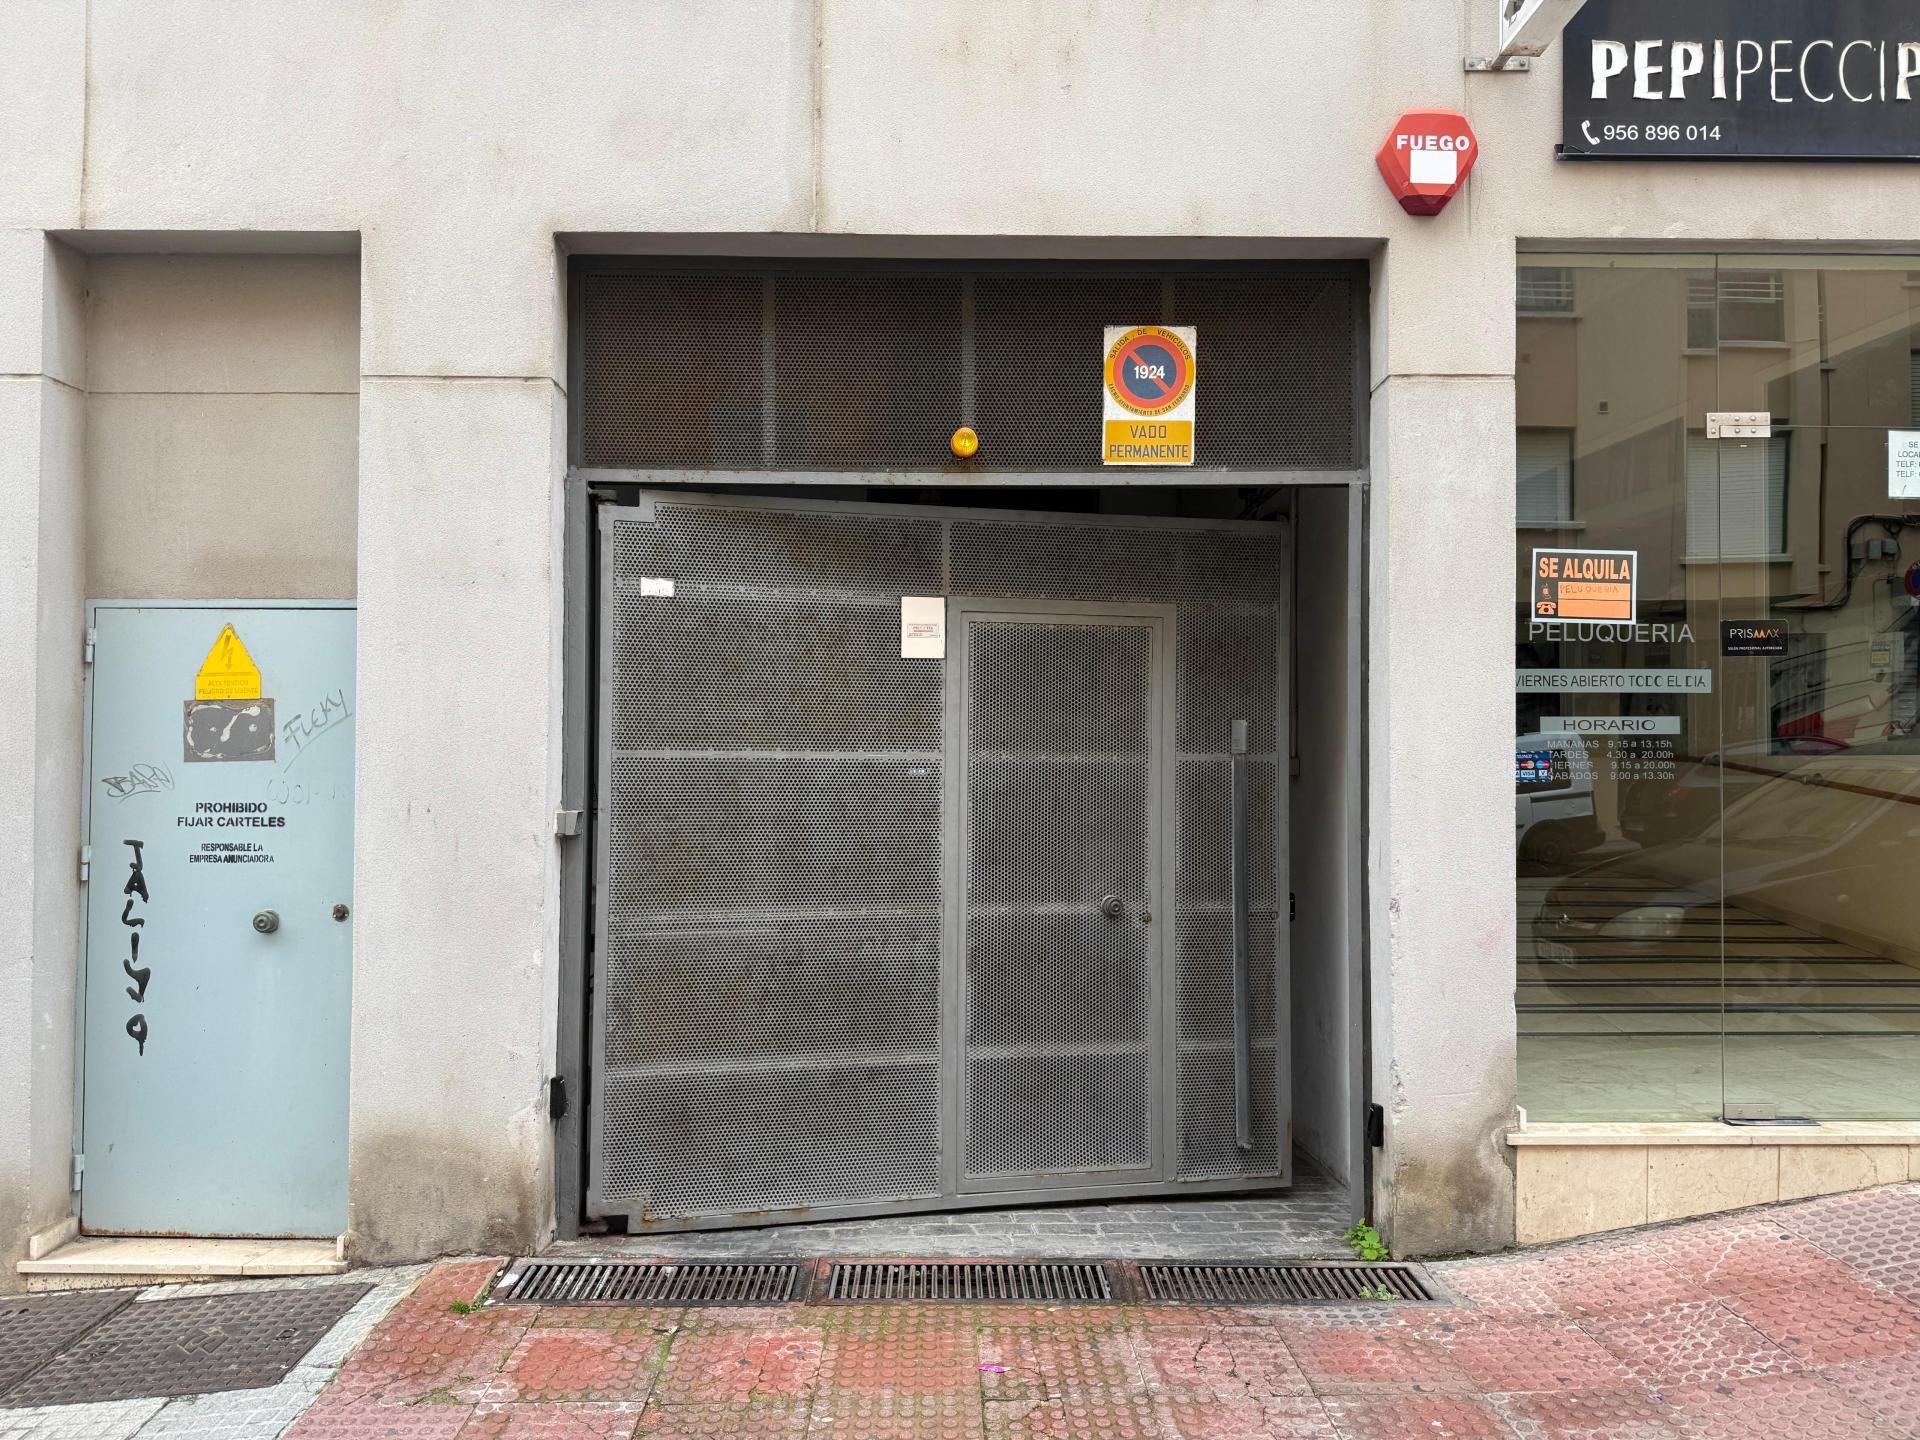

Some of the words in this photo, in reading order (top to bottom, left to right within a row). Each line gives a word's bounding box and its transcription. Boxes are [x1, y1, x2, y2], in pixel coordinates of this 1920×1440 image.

[1603, 124, 1639, 141] 956
[1645, 124, 1680, 141] 896
[1686, 124, 1721, 141] 014
[1396, 134, 1470, 151] FUEGO
[1110, 336, 1130, 360] SALIDA
[1137, 328, 1148, 336] DE
[1157, 328, 1191, 360] VEHICULOS
[1134, 365, 1165, 379] 1924
[1130, 425, 1167, 439] VADO
[1109, 444, 1189, 458] PERMANENTE
[1908, 441, 1918, 449] SE
[1539, 557, 1559, 578] SE
[1563, 558, 1631, 581] ALQUILA
[1529, 622, 1695, 643] PELUQUERIA
[1570, 675, 1625, 687] ABIERTO
[1667, 675, 1682, 687] EL
[1685, 675, 1706, 687] DIA
[1563, 719, 1656, 731] HORARIO
[1607, 740, 1629, 749] 9.15
[1630, 741, 1637, 749] a
[1640, 740, 1673, 749] 13.15h
[1549, 750, 1589, 759] TARDES
[1606, 750, 1628, 759] 4.30
[1641, 750, 1674, 759] 20.00h
[1551, 761, 1593, 770] IERNES
[1611, 761, 1632, 770] 9.15
[1643, 761, 1676, 770] 20.00h
[1610, 771, 1631, 780] 9.00
[1643, 771, 1675, 780] 13.30h
[195, 802, 268, 813] PROHIBIDO
[177, 816, 213, 827] FIJAR
[216, 816, 286, 828] CARTELES
[201, 843, 252, 852] RESPONSABLE
[253, 843, 264, 852] LA
[189, 854, 222, 863] EMPRESA
[223, 854, 275, 864] ANUNCIADORA
